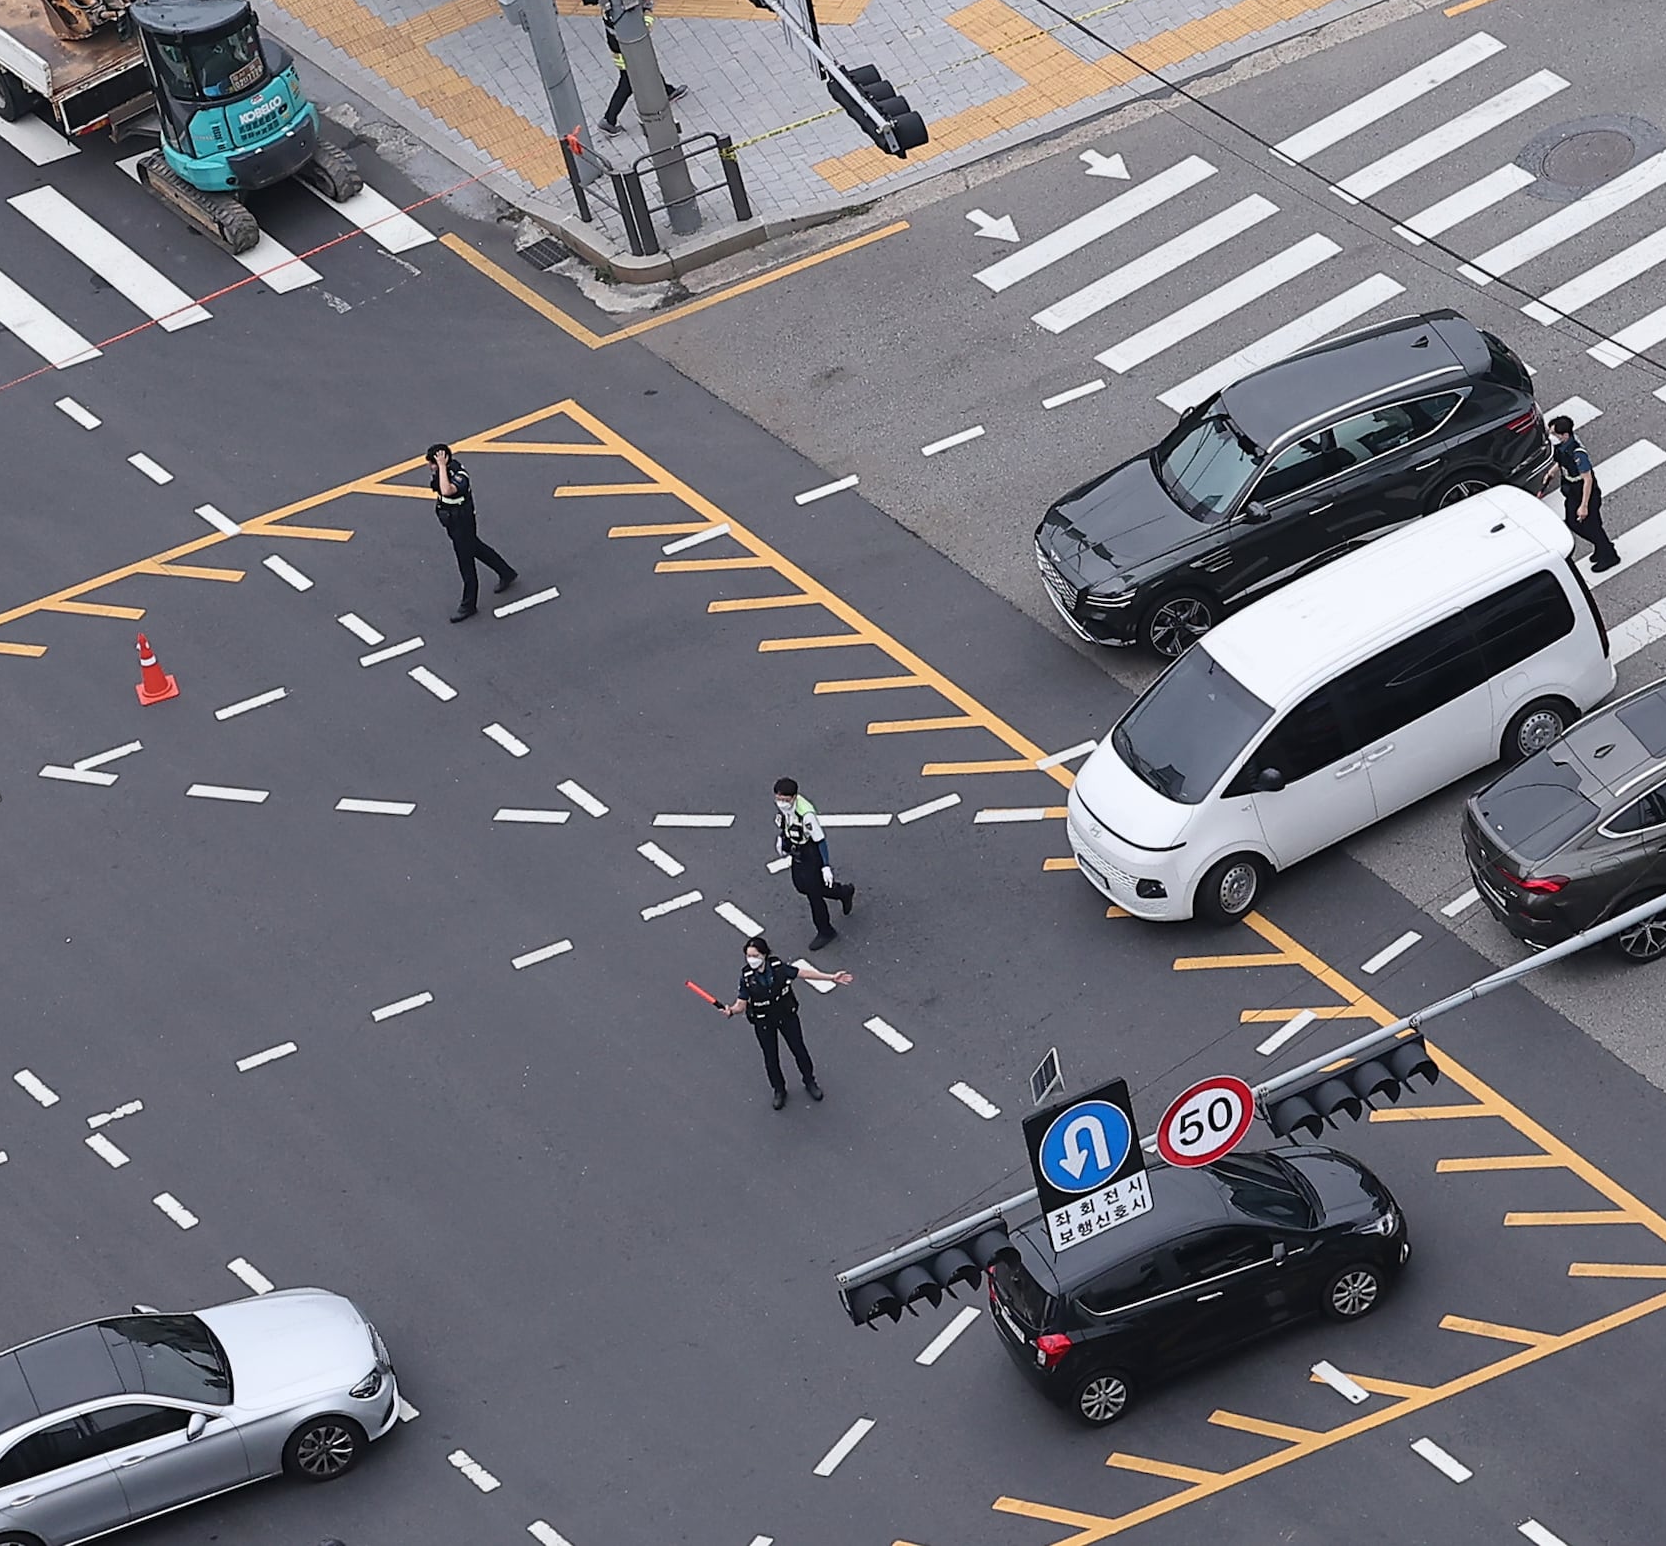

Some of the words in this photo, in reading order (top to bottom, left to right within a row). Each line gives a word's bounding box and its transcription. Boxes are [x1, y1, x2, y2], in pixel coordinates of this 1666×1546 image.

[239, 95, 283, 126] KOBELCO
[1178, 1096, 1234, 1147] 50
[1059, 1195, 1147, 1247] 보행신호시
